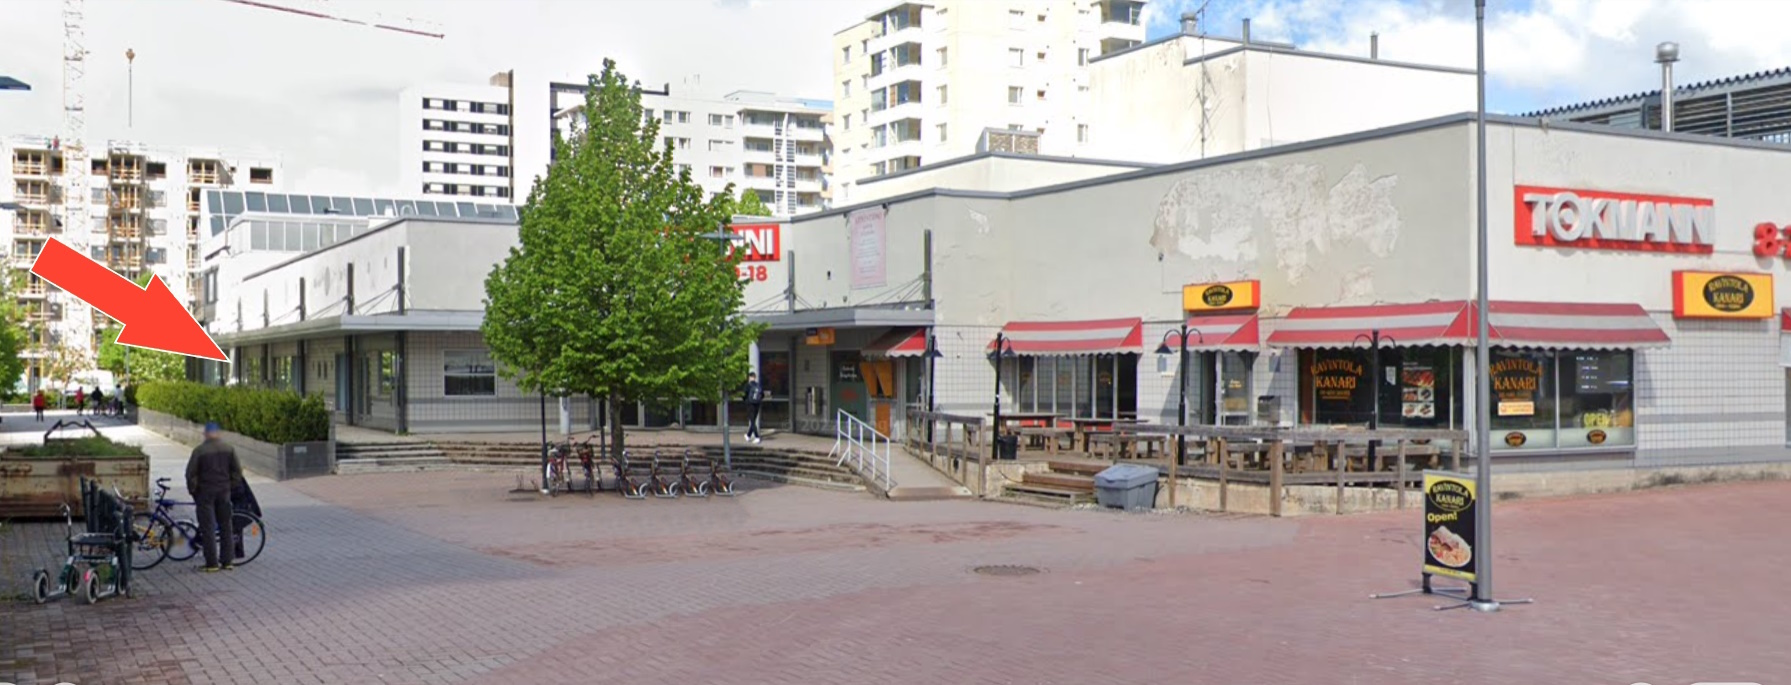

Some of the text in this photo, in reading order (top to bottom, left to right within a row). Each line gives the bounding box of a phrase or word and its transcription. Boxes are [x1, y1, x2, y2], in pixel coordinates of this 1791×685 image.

[735, 264, 767, 282] -18
[1712, 291, 1744, 304] KANARI
[1310, 359, 1364, 377] RAVINTOLA
[1489, 358, 1543, 377] RAVINTOLA
[1314, 376, 1356, 389] KANARI
[1493, 376, 1537, 391] KANARI
[1435, 492, 1464, 506] KANARI
[1427, 511, 1458, 524] Open!
